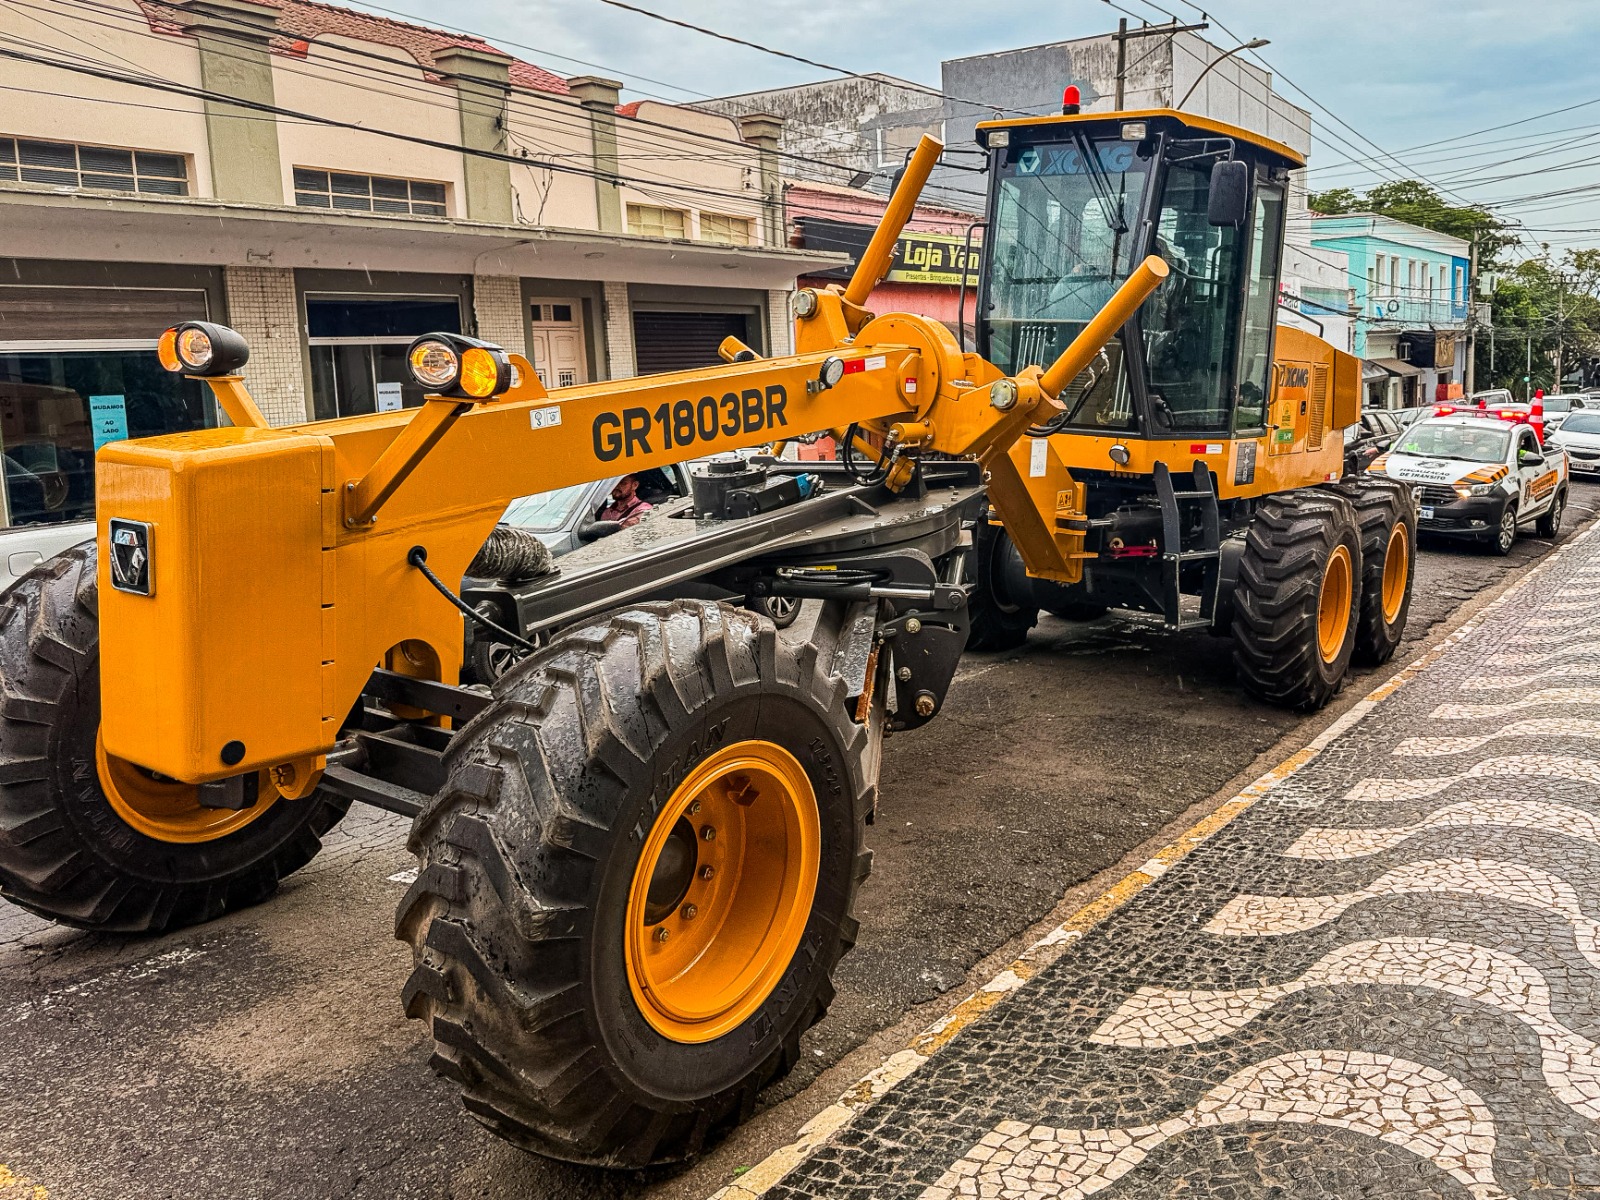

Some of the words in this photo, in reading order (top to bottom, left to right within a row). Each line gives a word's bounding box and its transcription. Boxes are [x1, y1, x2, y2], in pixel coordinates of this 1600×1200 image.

[904, 241, 942, 271] Loja
[906, 272, 926, 281] Presentes
[930, 274, 952, 282] Brinquedos
[1284, 368, 1309, 388] XCMG
[592, 384, 788, 462] GR1803BR
[629, 716, 731, 841] TITAN
